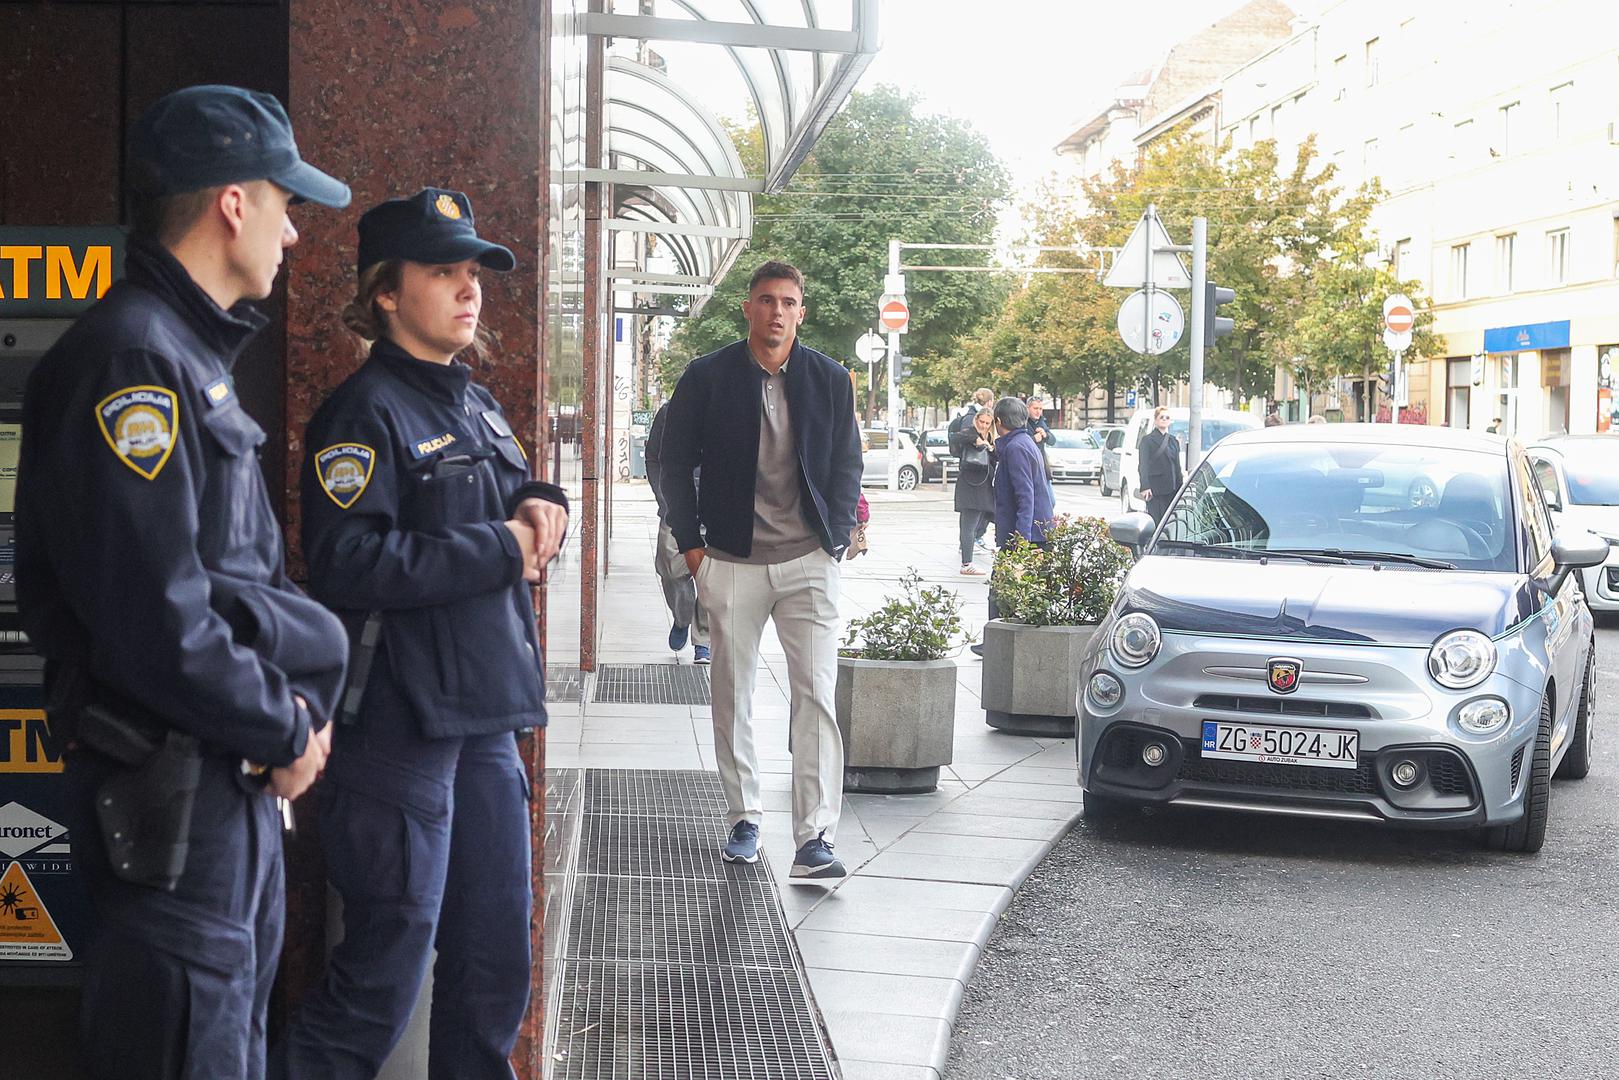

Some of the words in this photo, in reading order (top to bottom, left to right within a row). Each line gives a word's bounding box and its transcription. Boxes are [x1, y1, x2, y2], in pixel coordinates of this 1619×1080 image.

[0, 246, 112, 299] TM
[1204, 740, 1216, 749] HR
[1219, 727, 1247, 752] ZG
